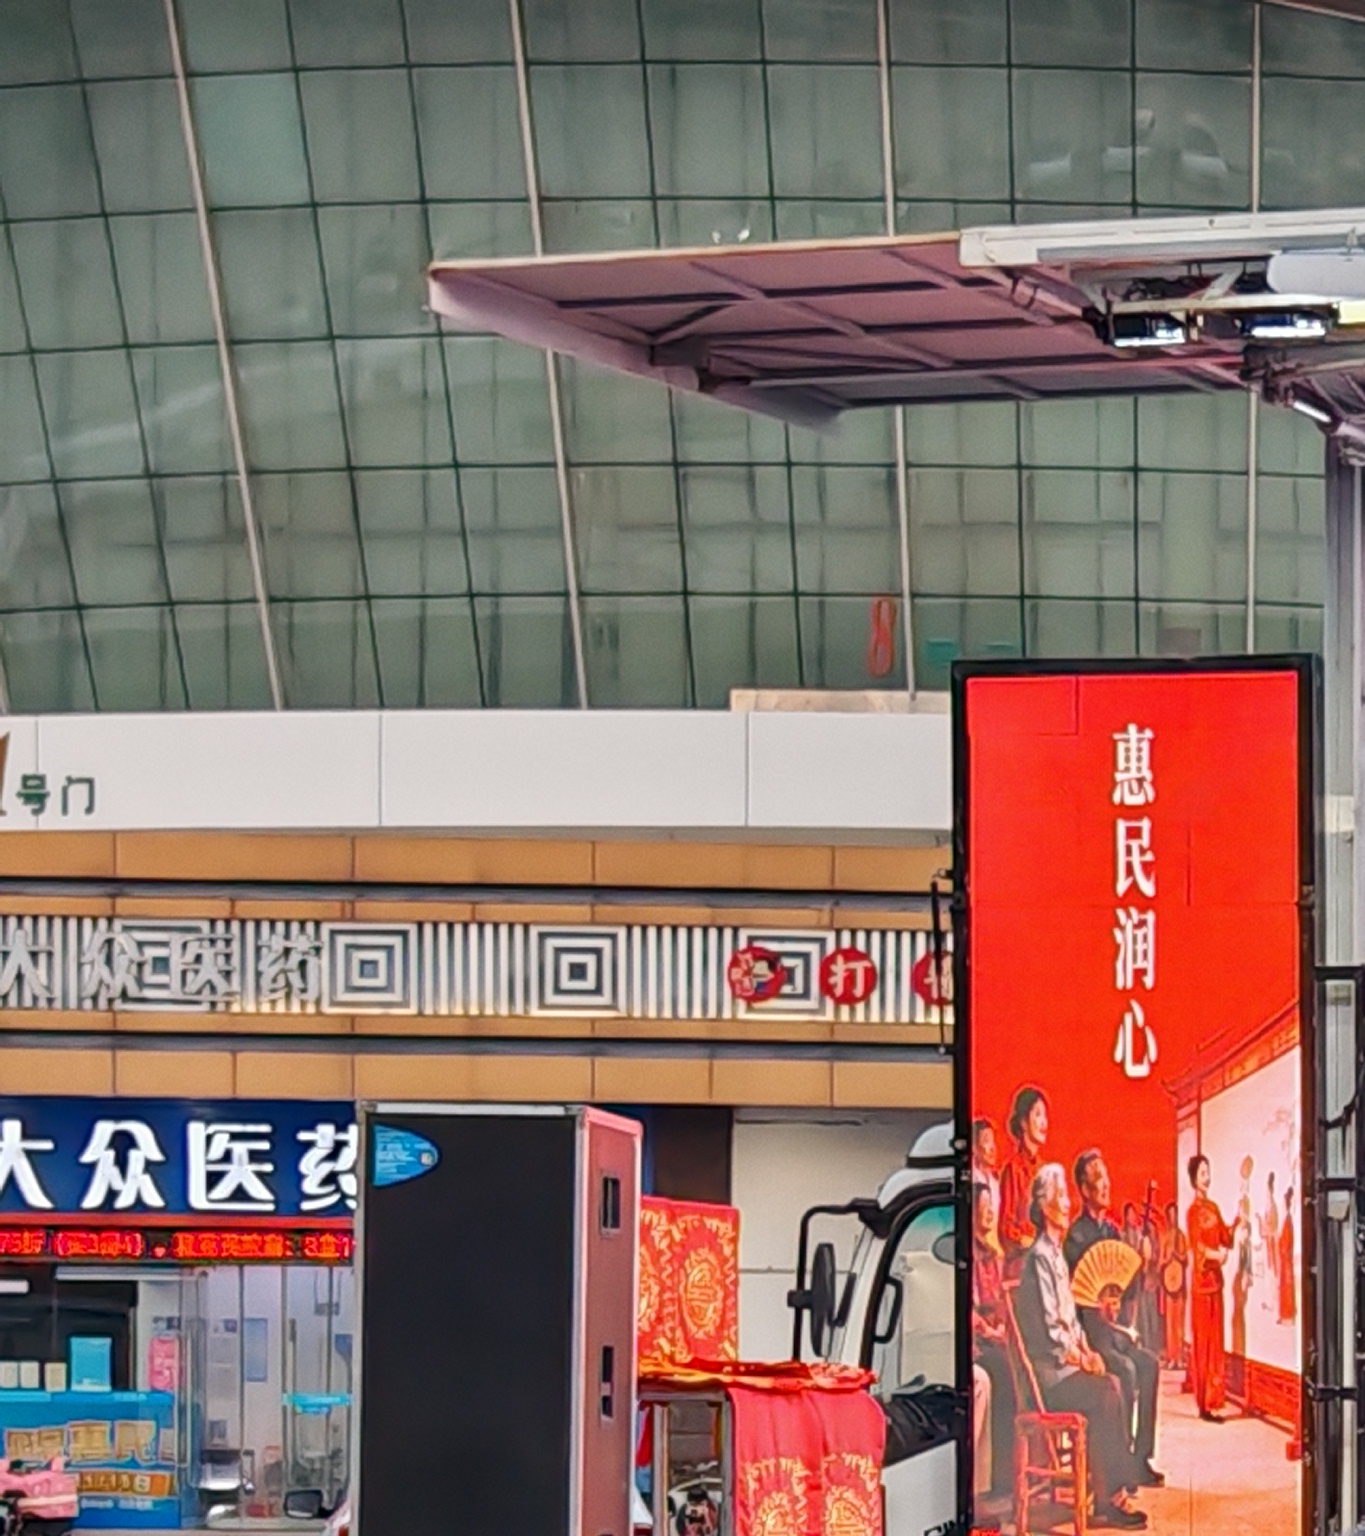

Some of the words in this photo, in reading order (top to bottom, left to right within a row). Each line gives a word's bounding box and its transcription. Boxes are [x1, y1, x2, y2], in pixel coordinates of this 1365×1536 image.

[1111, 723, 1158, 1078] 惠民润心
[0, 928, 323, 1003] 大众医药
[0, 1119, 356, 1211] 大众医药
